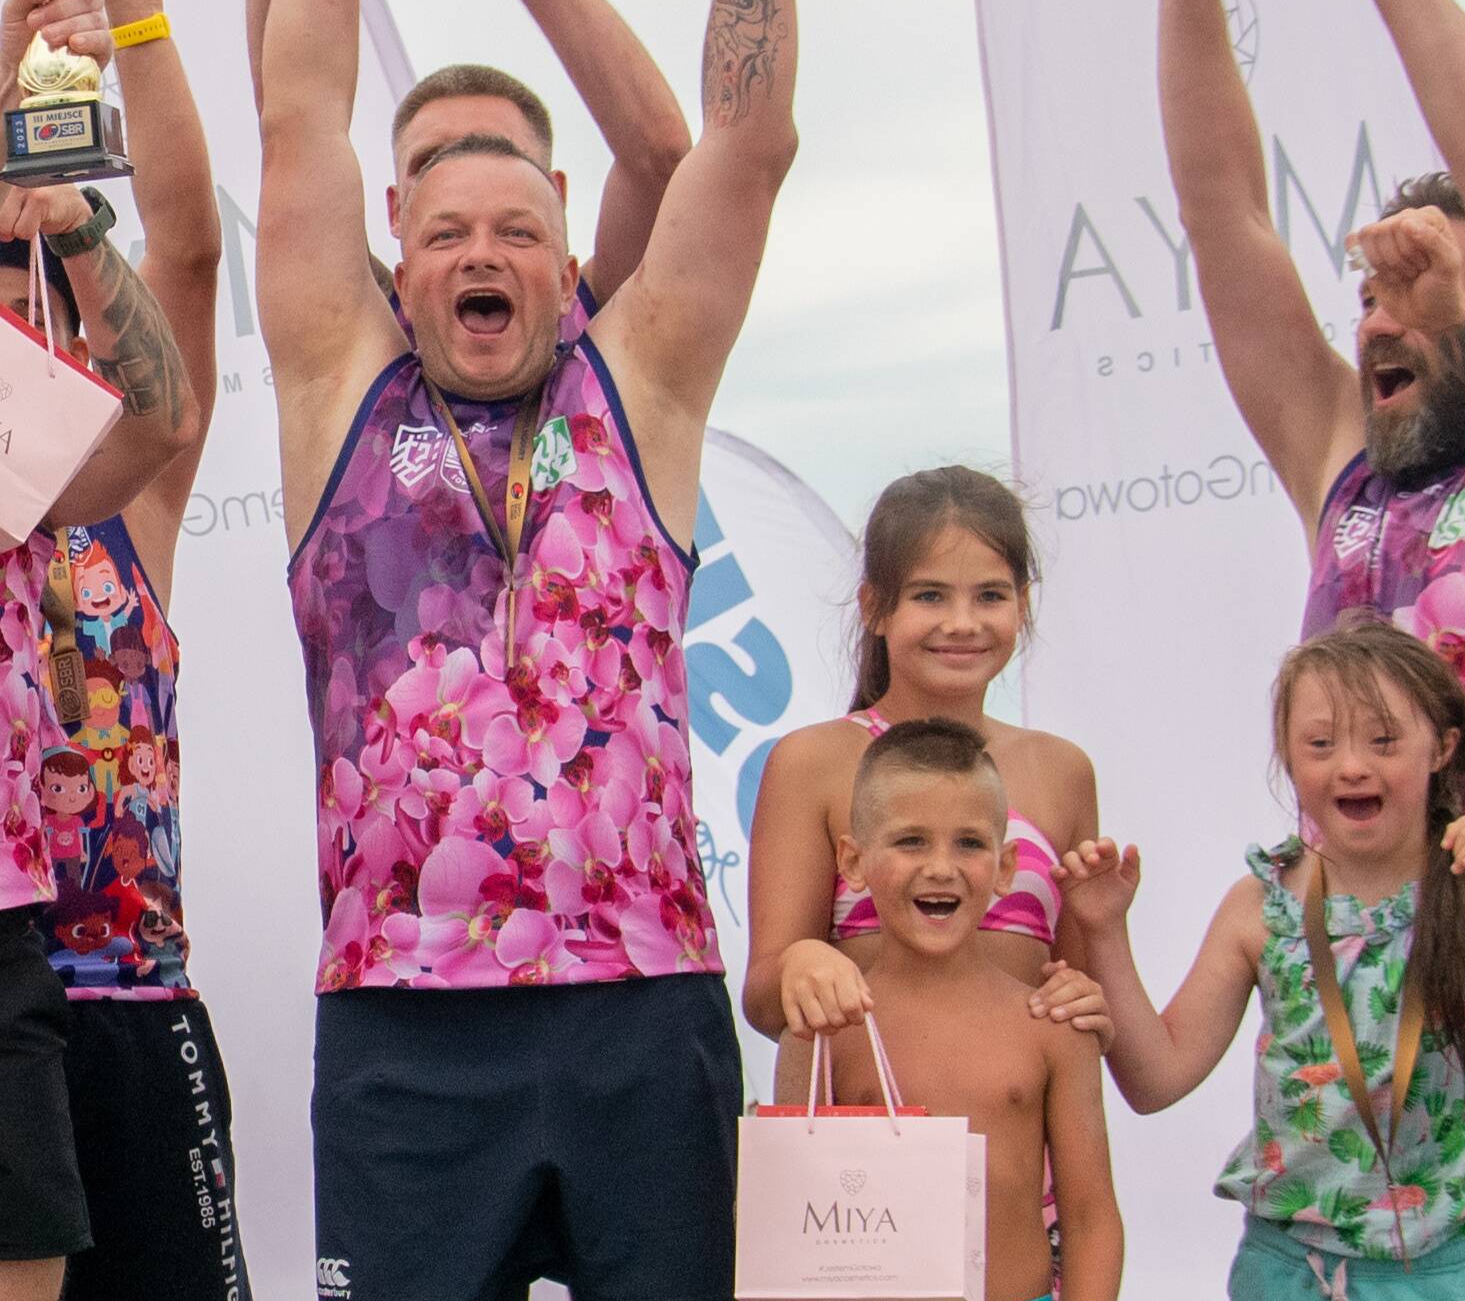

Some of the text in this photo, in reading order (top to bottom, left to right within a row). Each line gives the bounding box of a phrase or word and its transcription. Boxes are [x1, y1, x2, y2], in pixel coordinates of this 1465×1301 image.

[33, 110, 83, 123] III MIEJSCE
[61, 123, 84, 136] SBR
[15, 120, 26, 149] 2023
[171, 1014, 219, 1148] TOMMY
[189, 1147, 216, 1230] EST.1985
[802, 1200, 898, 1234] MIYA
